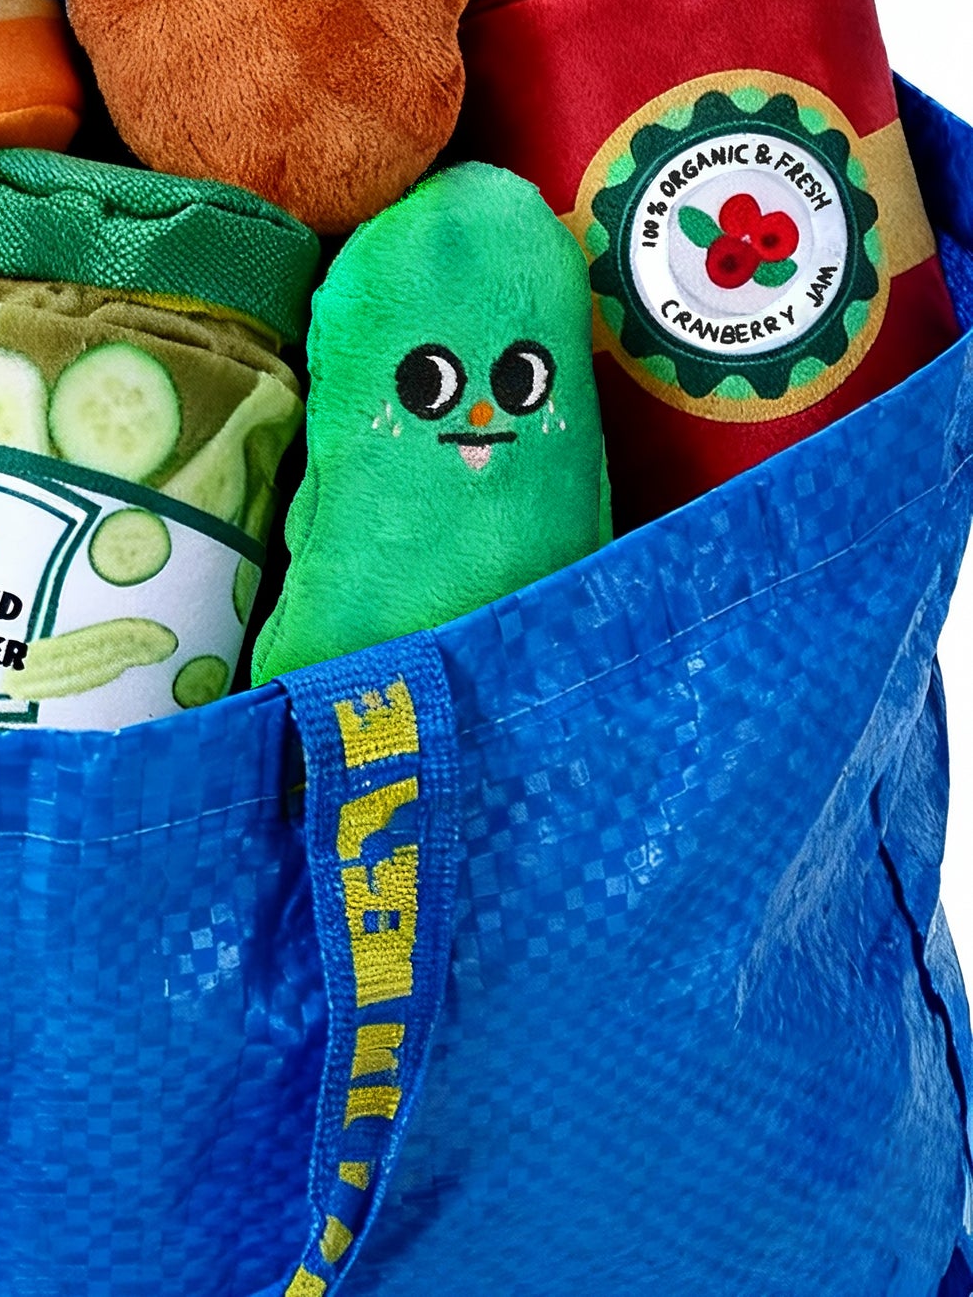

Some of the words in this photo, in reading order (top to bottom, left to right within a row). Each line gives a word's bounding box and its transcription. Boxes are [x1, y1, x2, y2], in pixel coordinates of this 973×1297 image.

[659, 144, 749, 198] ORGANIC
[755, 143, 773, 165] &
[774, 151, 833, 212] FRESH
[661, 299, 795, 344] CRANBERRY
[806, 266, 838, 308] JAM
